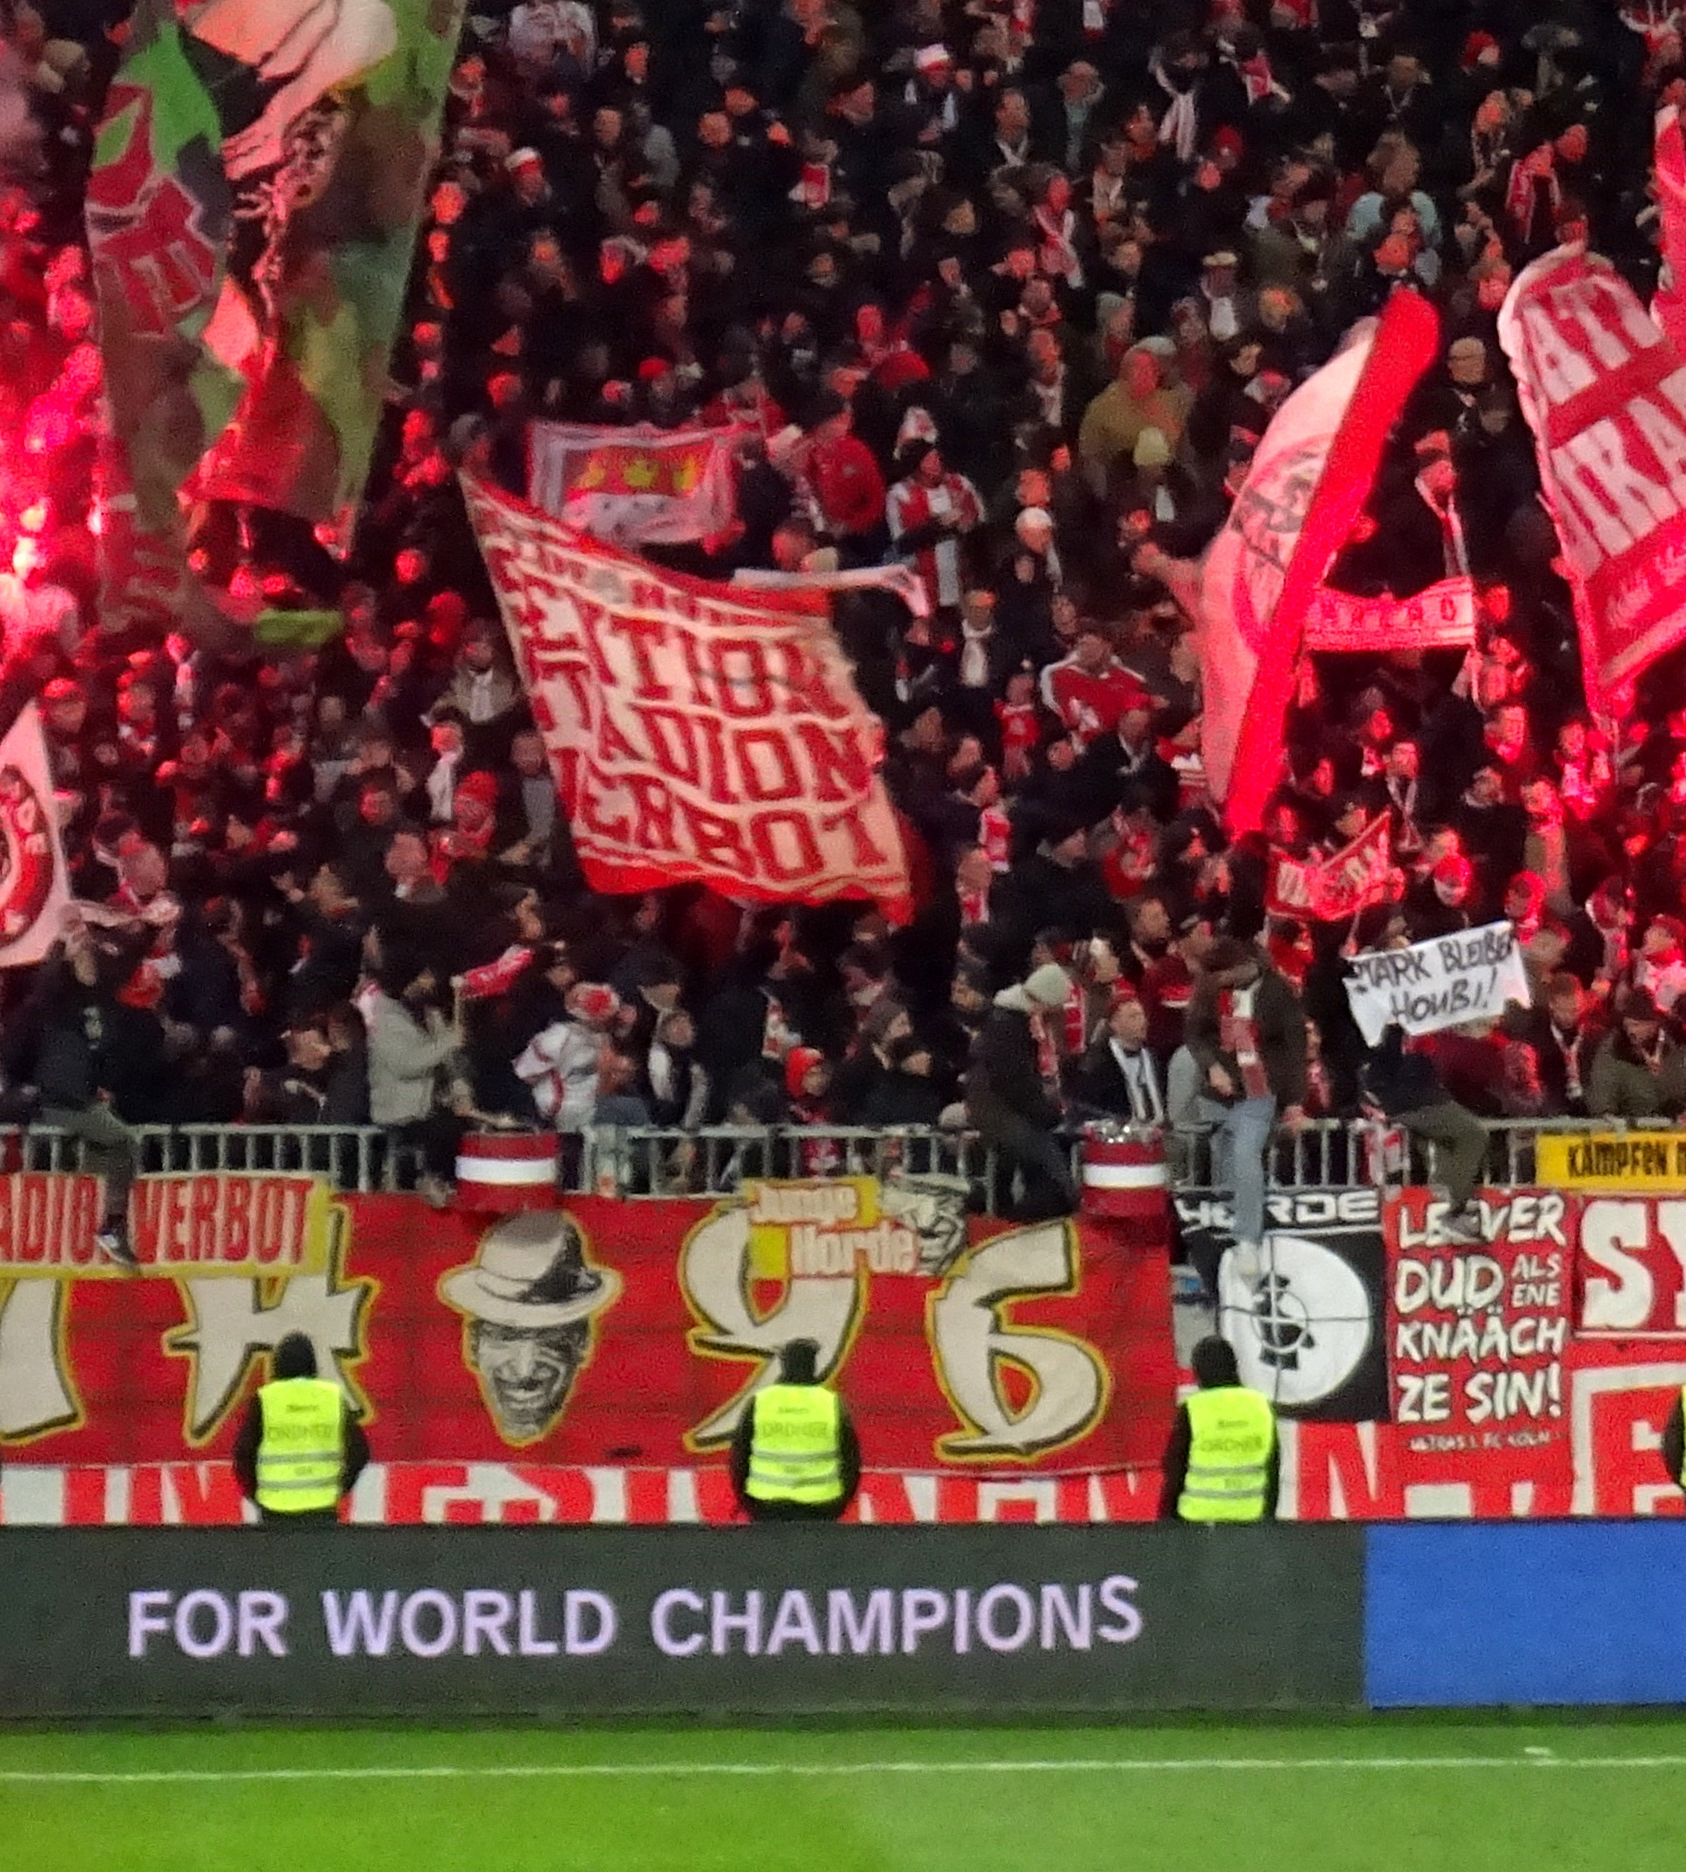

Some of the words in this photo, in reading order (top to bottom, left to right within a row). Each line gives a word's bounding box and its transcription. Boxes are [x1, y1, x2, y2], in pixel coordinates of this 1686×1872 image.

[129, 1176, 315, 1264] VERBOT
[1395, 1254, 1504, 1314] DUD
[1512, 1253, 1561, 1277] ALS
[1512, 1283, 1561, 1307] ENE
[1396, 1307, 1567, 1362] KNÄÄCH
[1397, 1373, 1451, 1423] ZE
[1465, 1362, 1561, 1424] SIN!
[128, 1590, 288, 1659] FOR
[323, 1589, 617, 1658] WORLD
[650, 1574, 1145, 1658] CHAMPIONS
